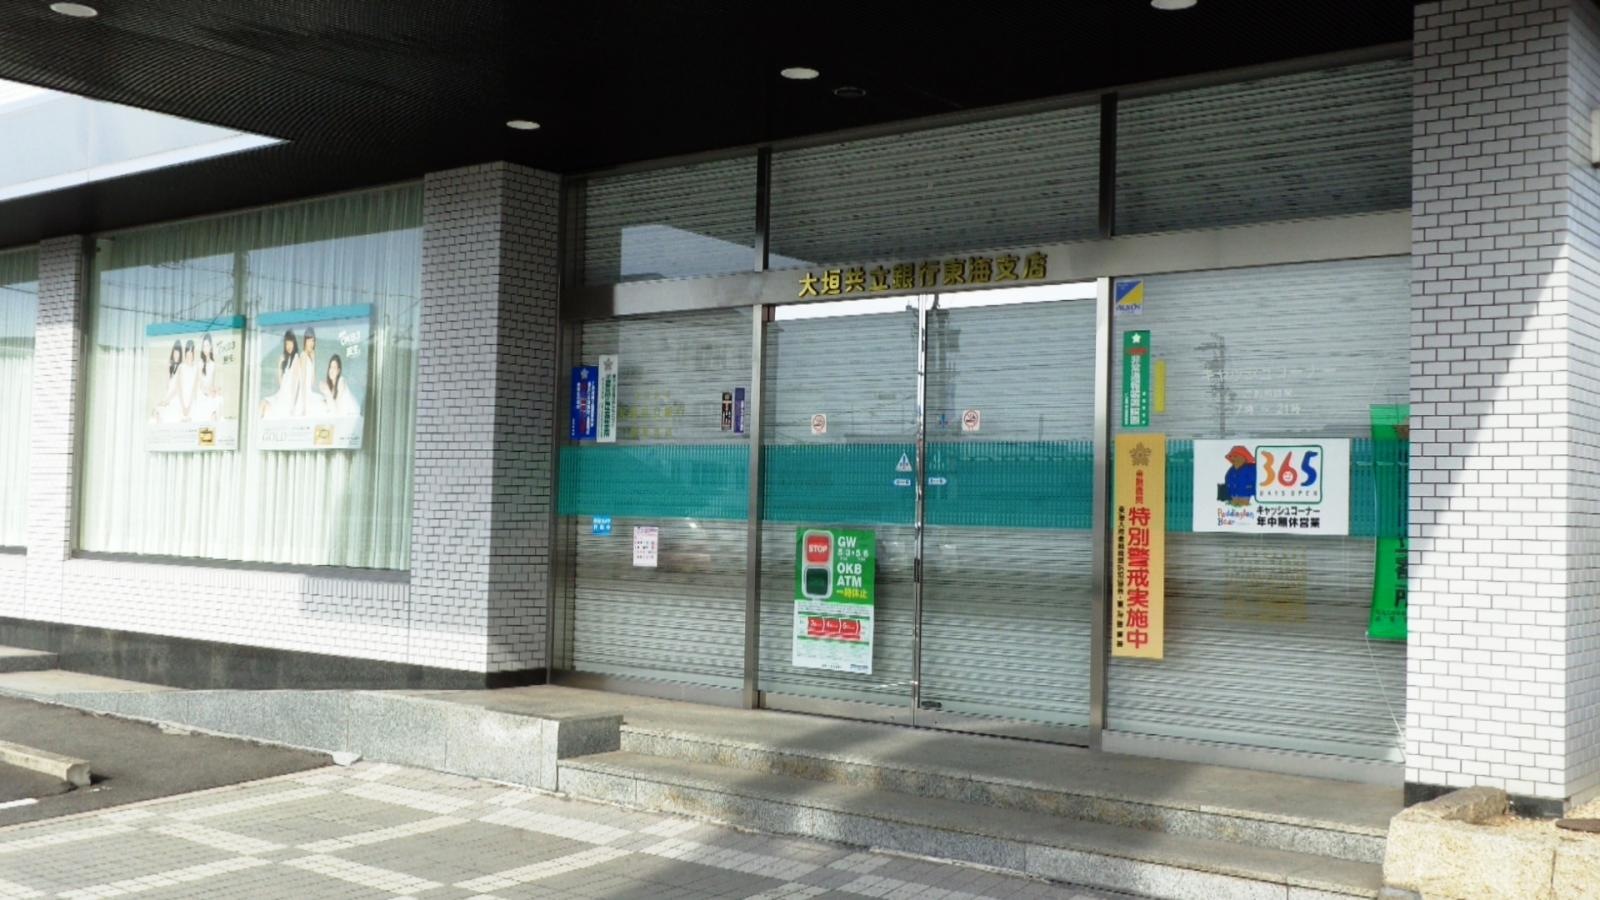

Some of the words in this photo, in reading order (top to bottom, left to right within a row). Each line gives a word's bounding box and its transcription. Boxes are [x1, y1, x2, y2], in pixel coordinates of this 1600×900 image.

[798, 251, 1047, 297] 大垣共立銀行東海支店
[1258, 451, 1319, 487] 365
[1256, 506, 1321, 516] キャッシュコーナー
[1256, 516, 1321, 528] 年中無休営業
[808, 544, 828, 553] STOP
[837, 536, 857, 548] GW
[836, 562, 862, 575] OKB
[836, 575, 862, 588] ATM
[1126, 506, 1151, 649] 特別警戒実施中
